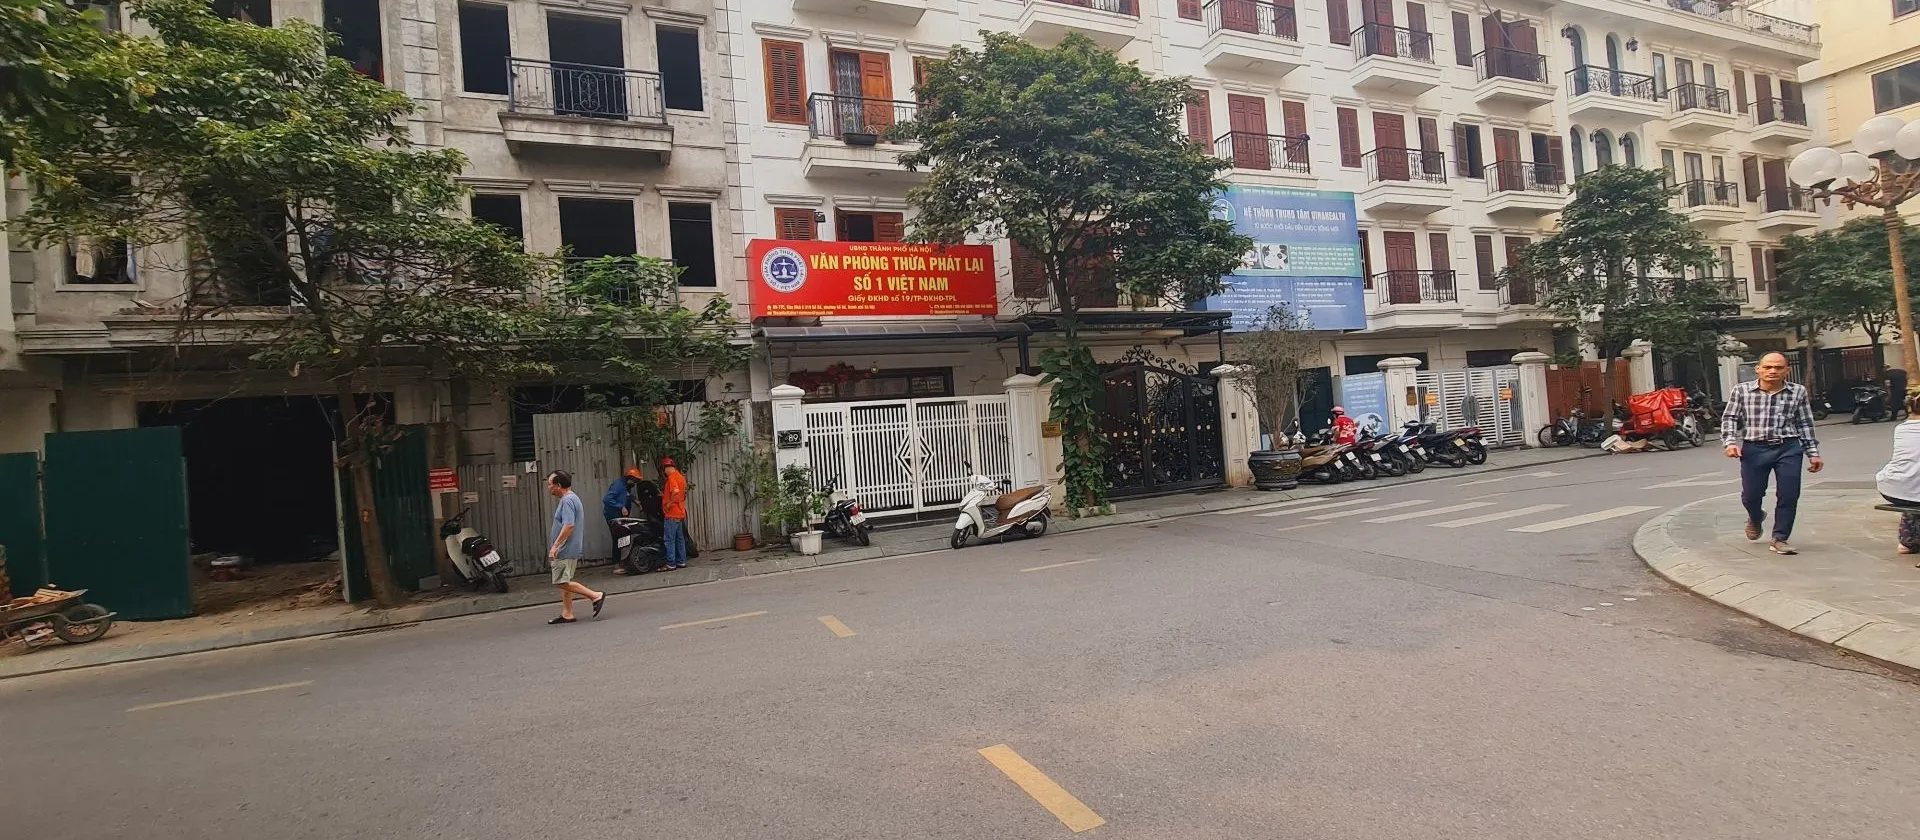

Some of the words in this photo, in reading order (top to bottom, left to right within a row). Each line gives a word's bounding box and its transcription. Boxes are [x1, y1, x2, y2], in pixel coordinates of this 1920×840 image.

[1253, 205, 1274, 218] THỐNG
[1275, 209, 1296, 220] TRUNG
[1296, 208, 1310, 220] TÂM
[894, 244, 908, 252] PHỐ
[908, 245, 919, 253] HÀ
[920, 246, 932, 254] NỘI
[810, 252, 839, 270] VĂN
[842, 252, 889, 271] PHÒNG
[892, 254, 927, 271] THỪA
[929, 254, 961, 272] PHÁT
[965, 258, 984, 274] LẠI
[854, 272, 872, 291] SỐ
[876, 277, 882, 291] 1
[888, 274, 915, 294] VIỆT
[918, 276, 948, 291] NAM
[848, 294, 866, 303] Giấy
[891, 294, 900, 302] số
[788, 433, 799, 442] 89
